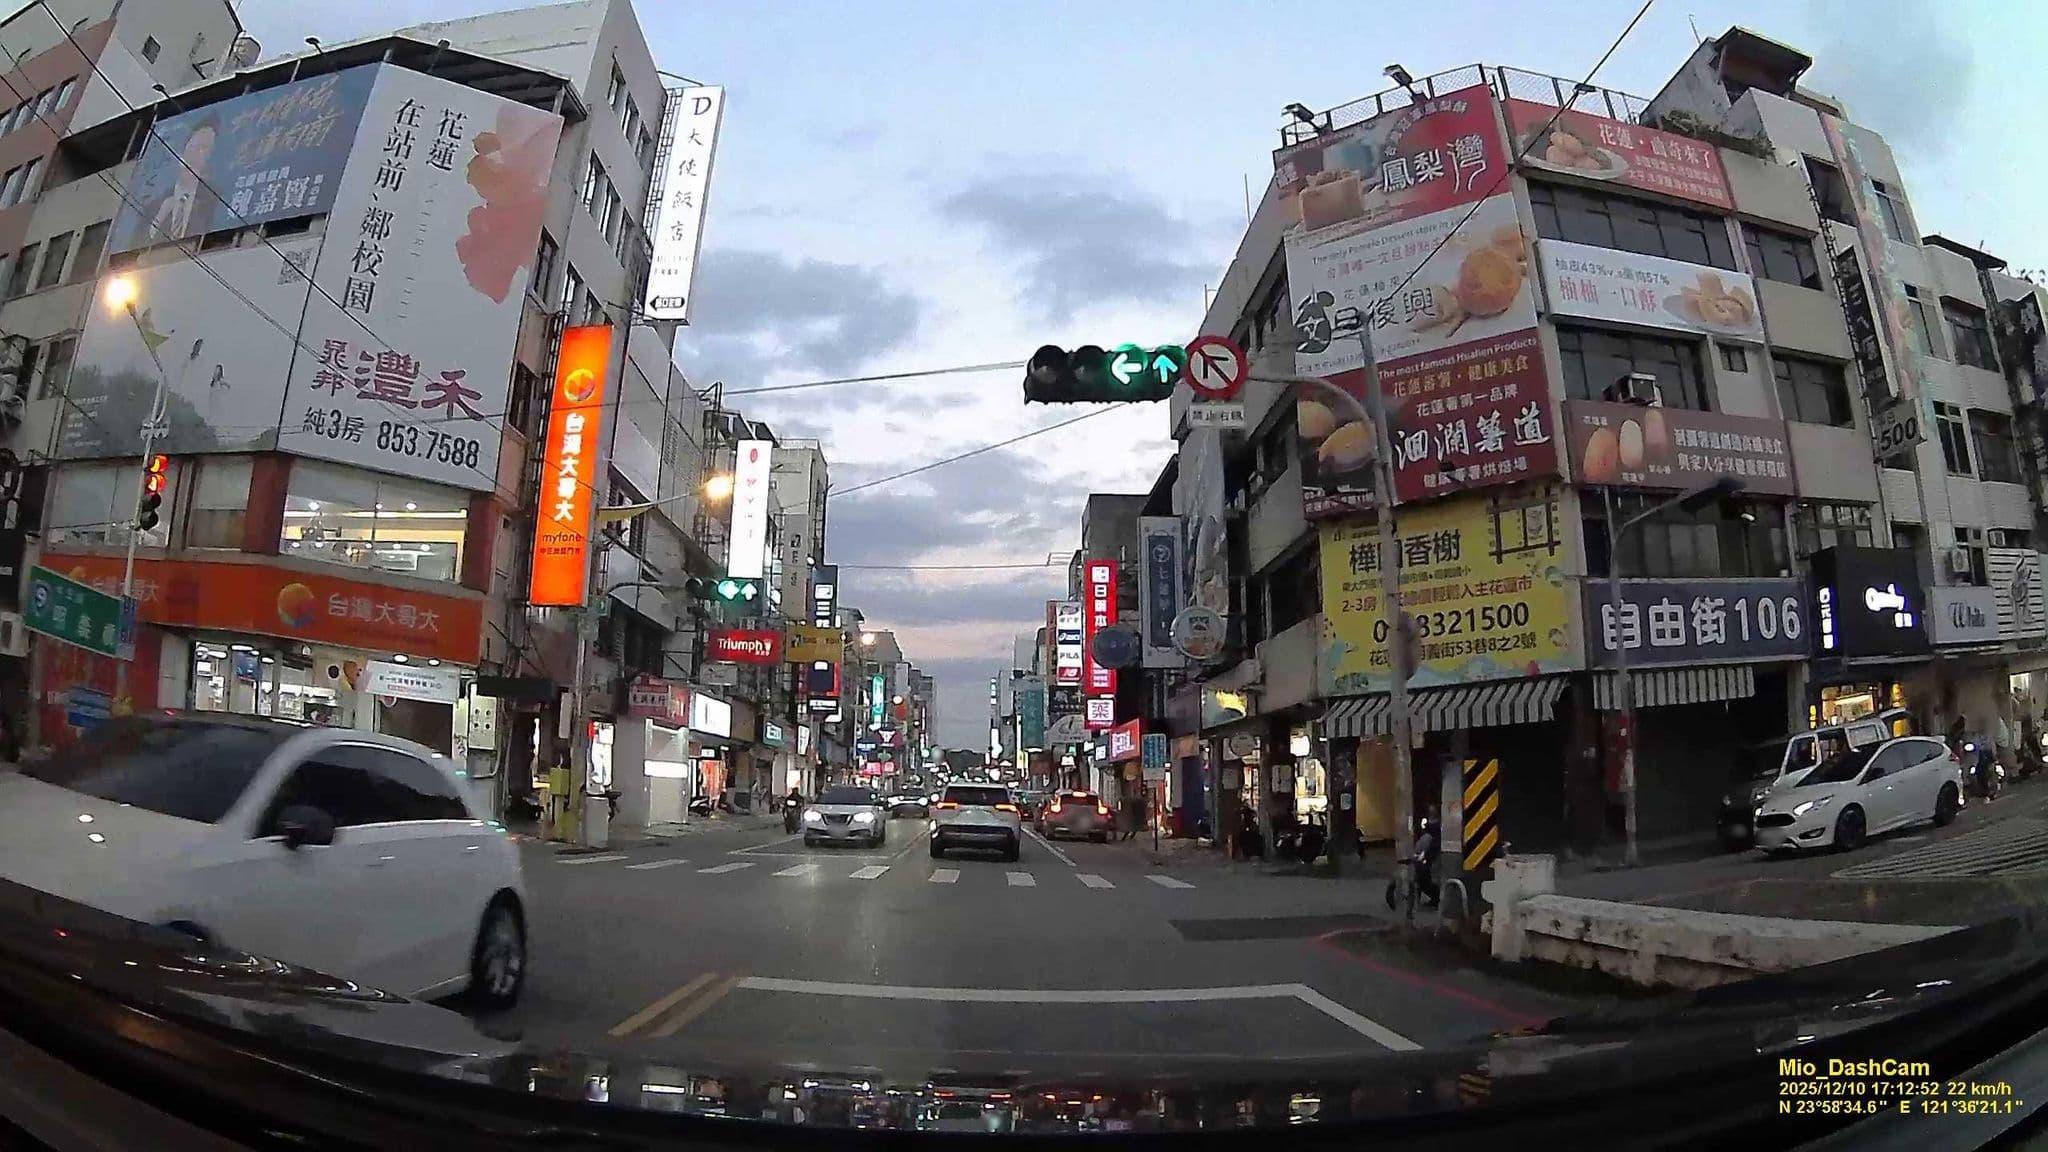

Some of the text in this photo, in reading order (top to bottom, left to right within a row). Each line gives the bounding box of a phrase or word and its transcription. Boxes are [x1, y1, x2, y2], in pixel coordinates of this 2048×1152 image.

[691, 96, 712, 115] D
[425, 107, 468, 172] 花蓮
[342, 97, 426, 314] 在站前、鄰校園
[670, 128, 704, 242] 大使飯店
[1378, 336, 1538, 380] The most famous Hualien Products
[303, 406, 480, 469] 純3房 853.7588
[1881, 417, 1917, 451] 500
[554, 412, 585, 522] 台灣大哥大
[543, 531, 582, 544] myfone
[328, 592, 440, 633] 台灣大哥大
[1601, 596, 1801, 650] 自由街106
[718, 637, 763, 653] Triumph
[1059, 652, 1080, 660] FILA
